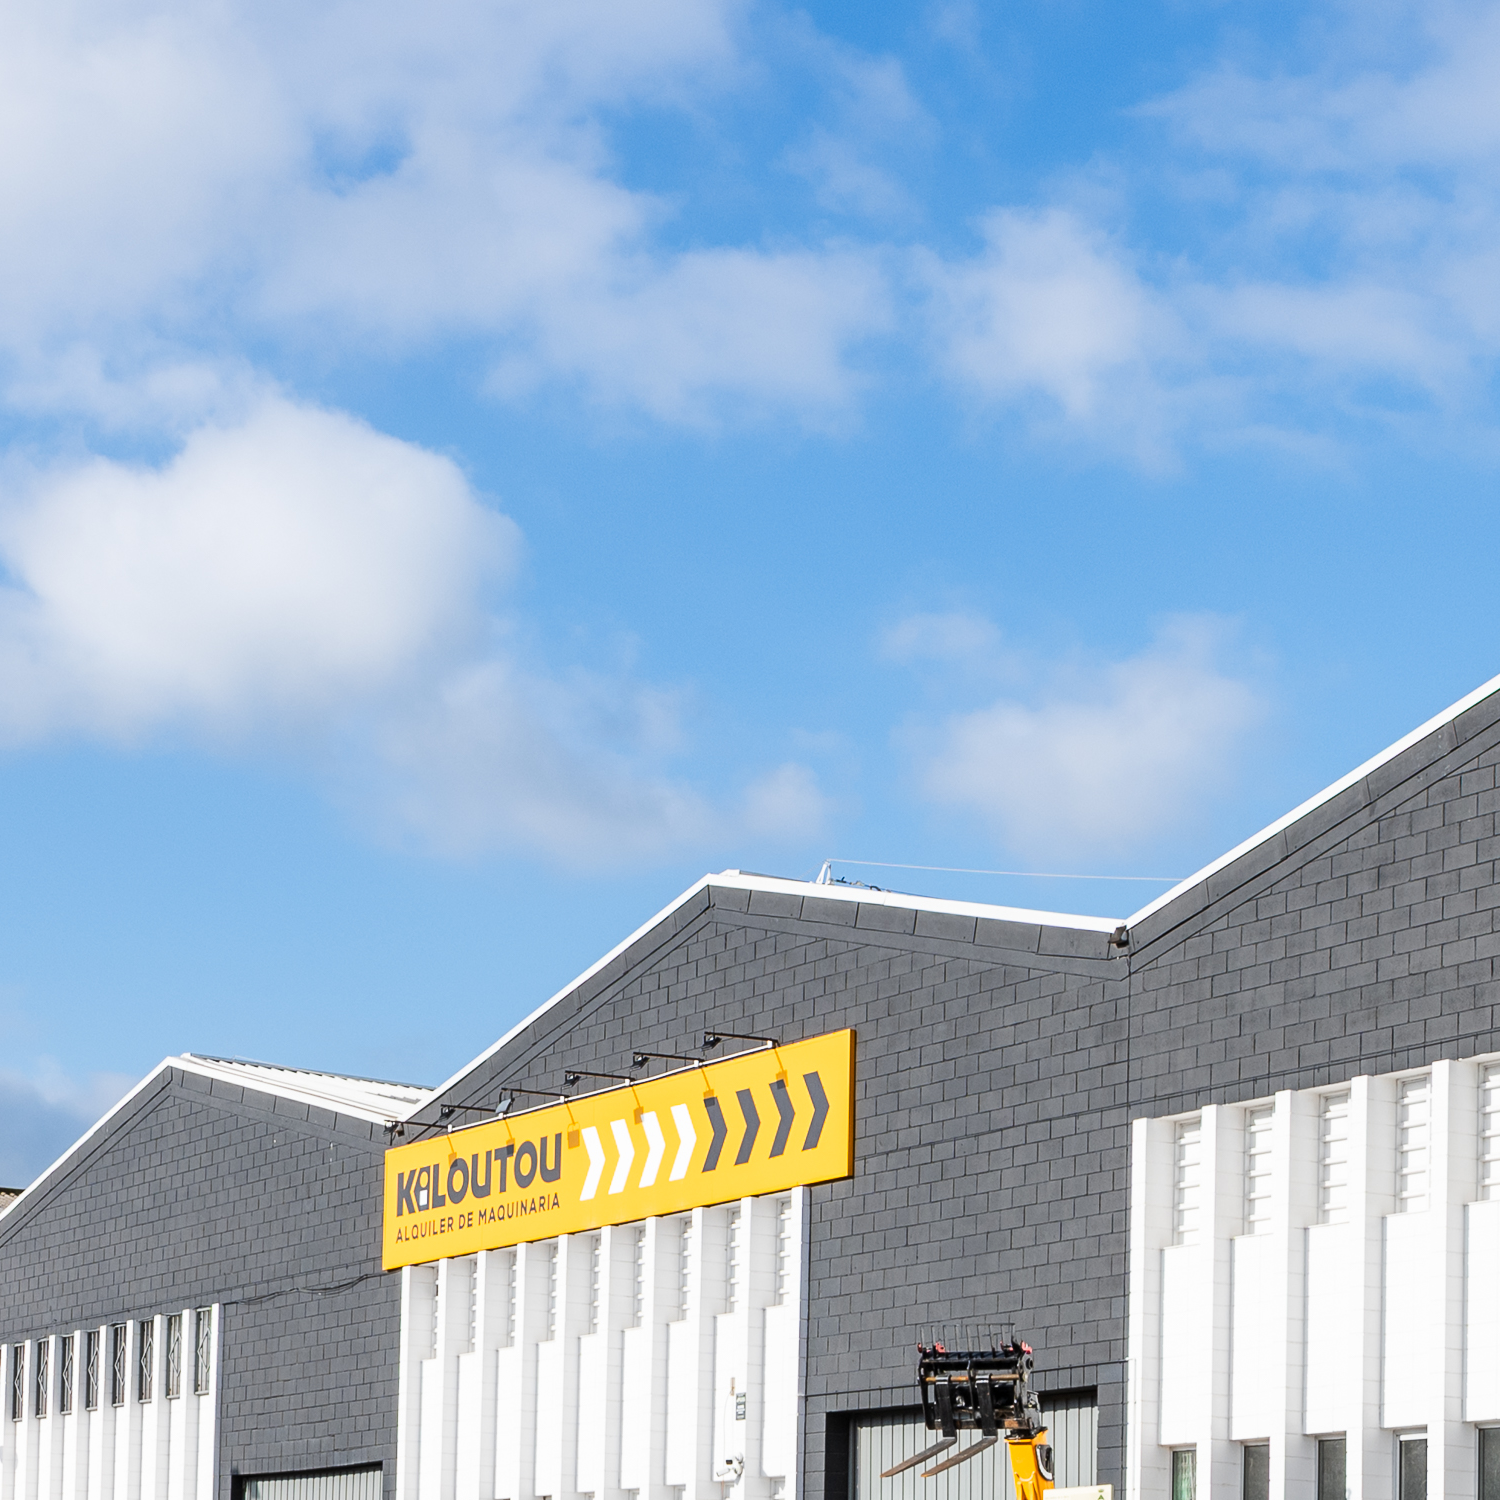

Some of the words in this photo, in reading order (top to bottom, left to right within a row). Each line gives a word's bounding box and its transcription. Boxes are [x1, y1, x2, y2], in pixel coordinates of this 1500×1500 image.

[395, 1216, 455, 1244] ALQUILER
[458, 1211, 474, 1230] DE
[478, 1192, 561, 1226] MAQUINARIA
